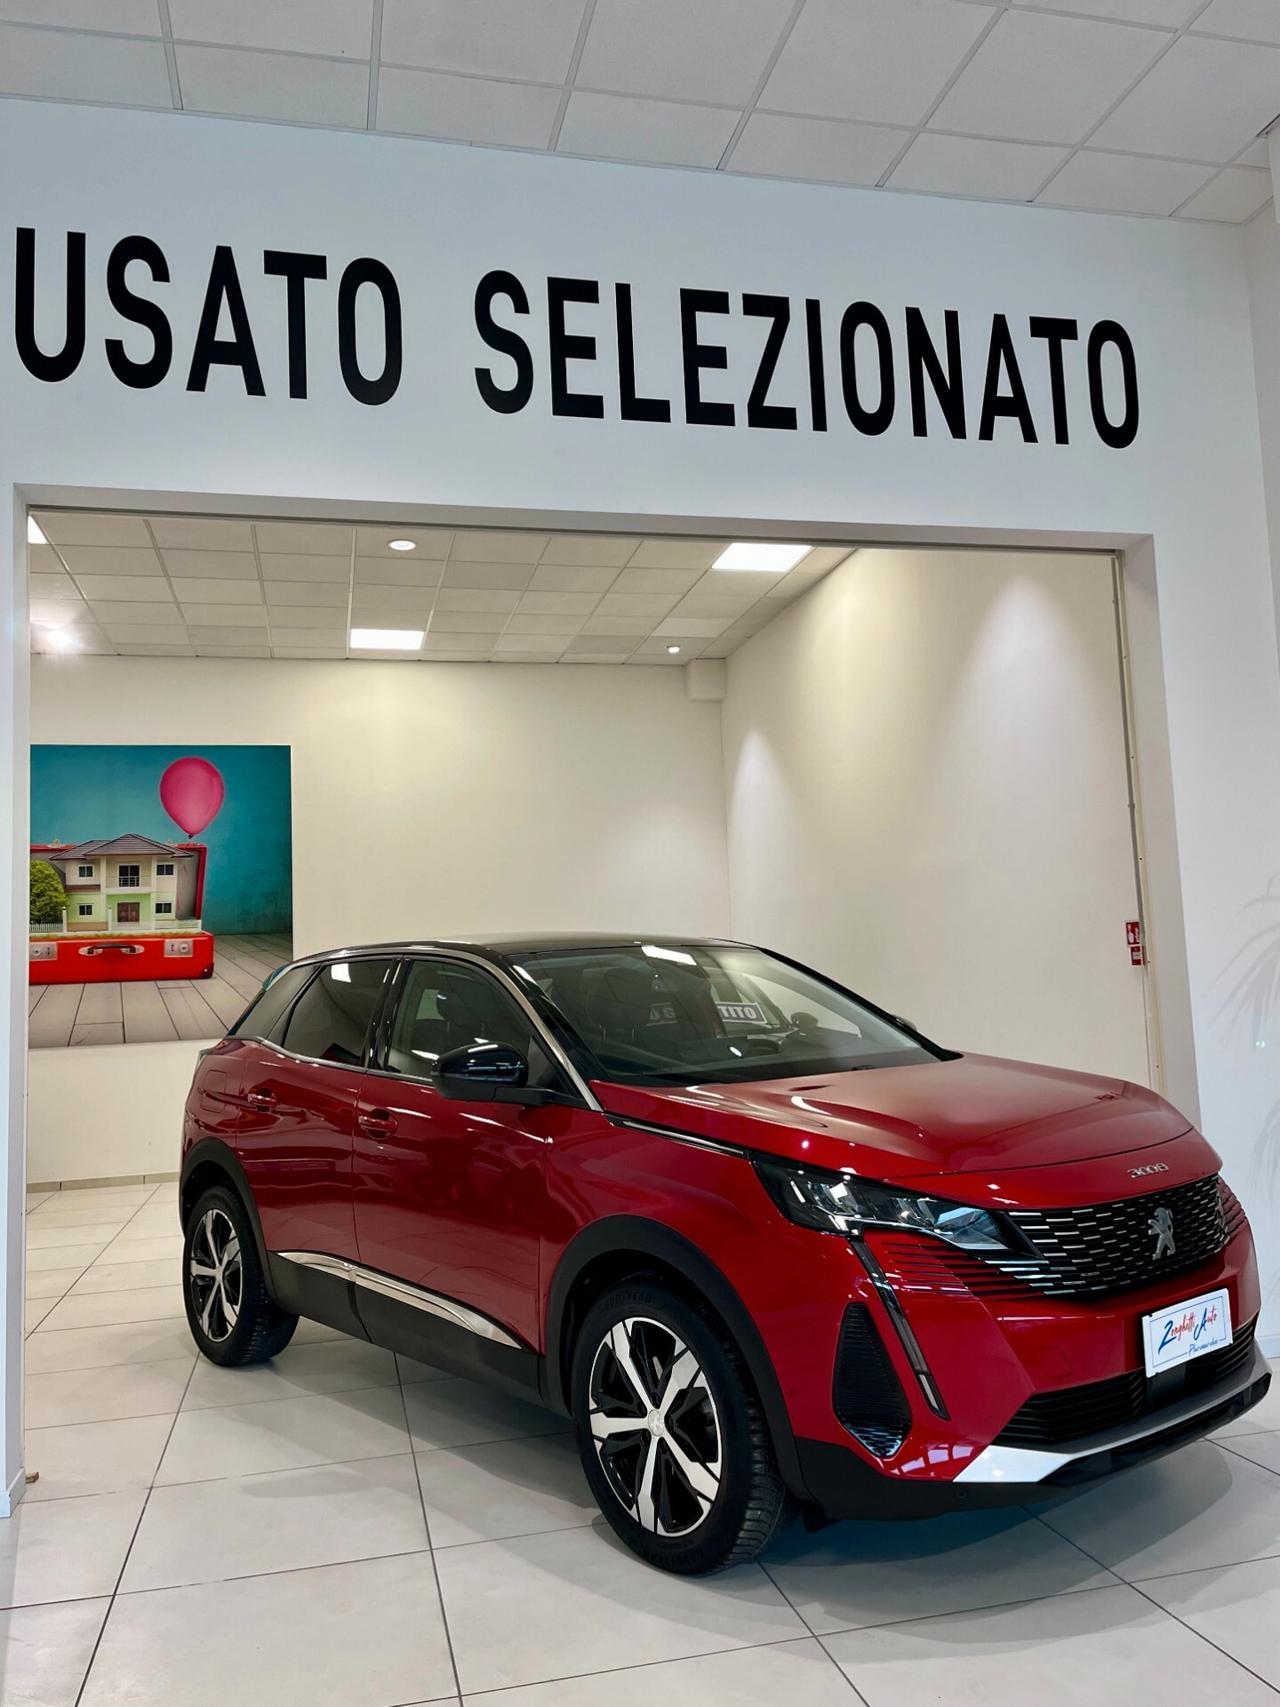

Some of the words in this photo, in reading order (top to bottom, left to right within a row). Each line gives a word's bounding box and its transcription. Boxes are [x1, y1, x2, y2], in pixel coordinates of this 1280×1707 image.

[15, 227, 402, 405] USATO
[474, 270, 1140, 448] SELEZIONATO
[1127, 1162, 1169, 1178] 3008
[1193, 1305, 1217, 1341] Auto
